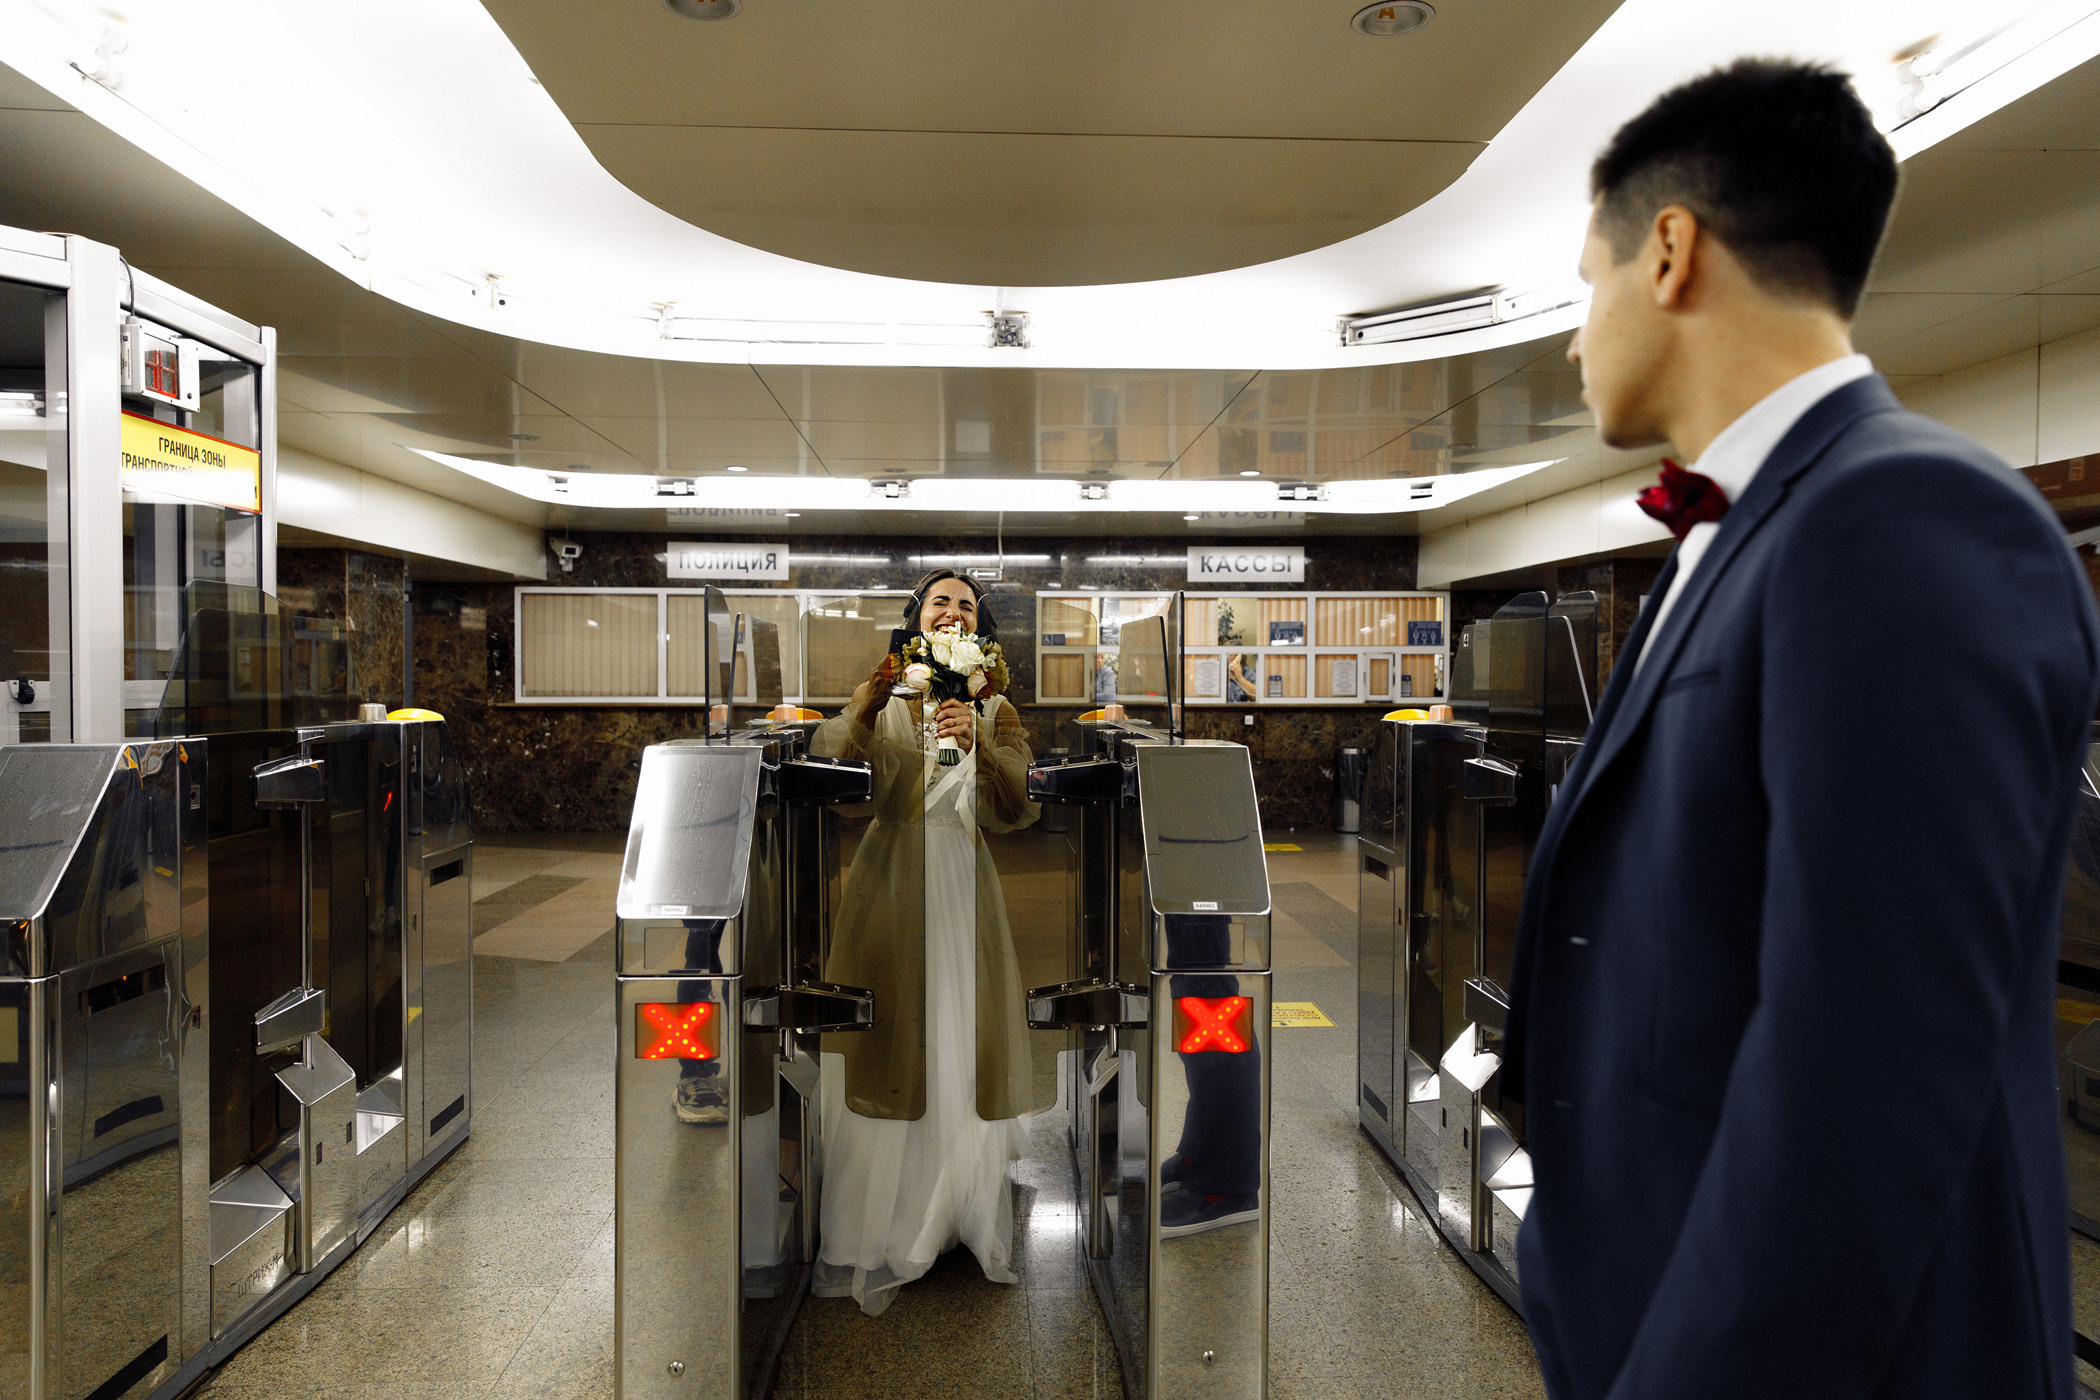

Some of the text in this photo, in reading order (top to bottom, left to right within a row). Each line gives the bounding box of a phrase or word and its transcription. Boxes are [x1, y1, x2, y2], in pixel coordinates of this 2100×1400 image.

[158, 437, 226, 468] ГРАНИЦА ЗОНЫ
[679, 551, 777, 573] ПОЛИЦИЯ
[1200, 555, 1292, 573] КАССЫ
